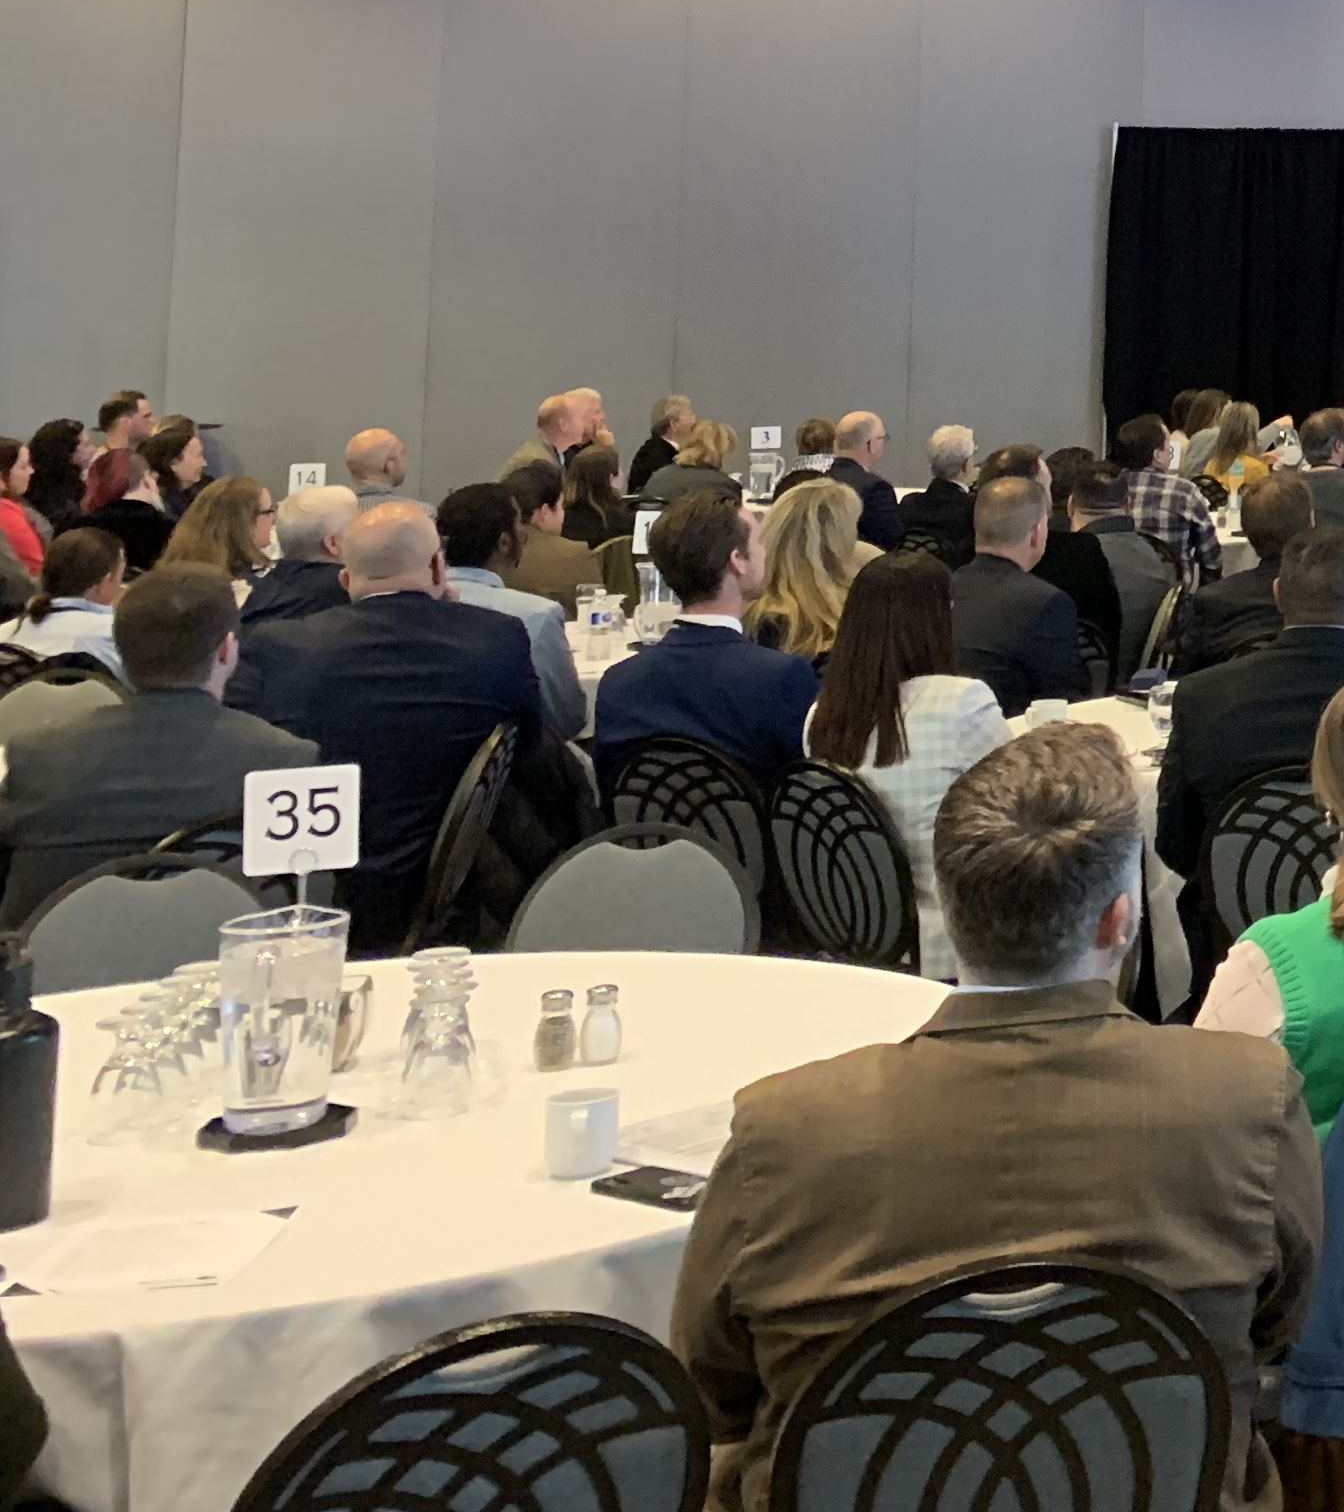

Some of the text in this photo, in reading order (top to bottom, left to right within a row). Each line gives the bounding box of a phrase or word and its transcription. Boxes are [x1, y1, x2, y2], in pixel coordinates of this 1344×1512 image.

[761, 431, 771, 444] 3
[297, 470, 317, 486] 14
[265, 786, 341, 841] 35
